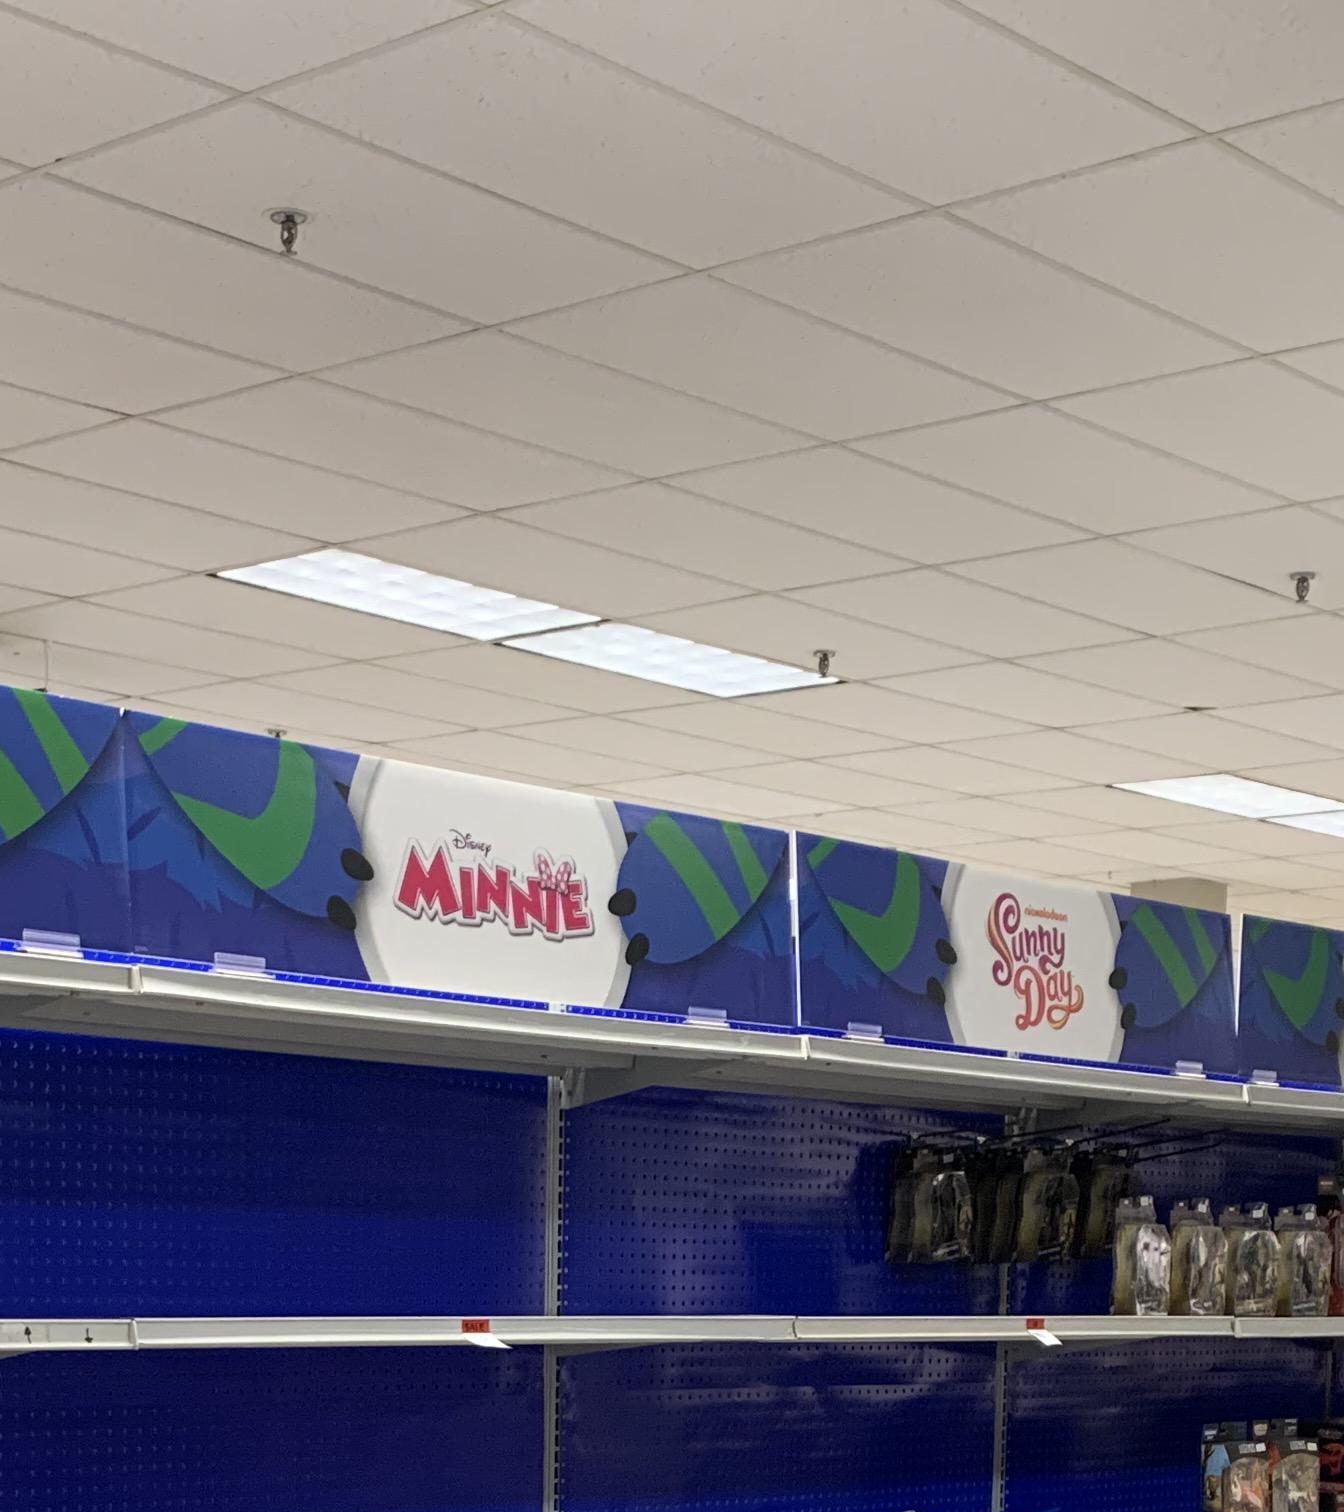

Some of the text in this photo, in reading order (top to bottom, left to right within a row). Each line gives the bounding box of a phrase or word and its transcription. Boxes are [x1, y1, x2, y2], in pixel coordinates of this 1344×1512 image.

[449, 829, 492, 858] Disney
[397, 846, 591, 935] MINNIE
[986, 893, 1065, 986] Sunny
[1014, 965, 1084, 1030] Day
